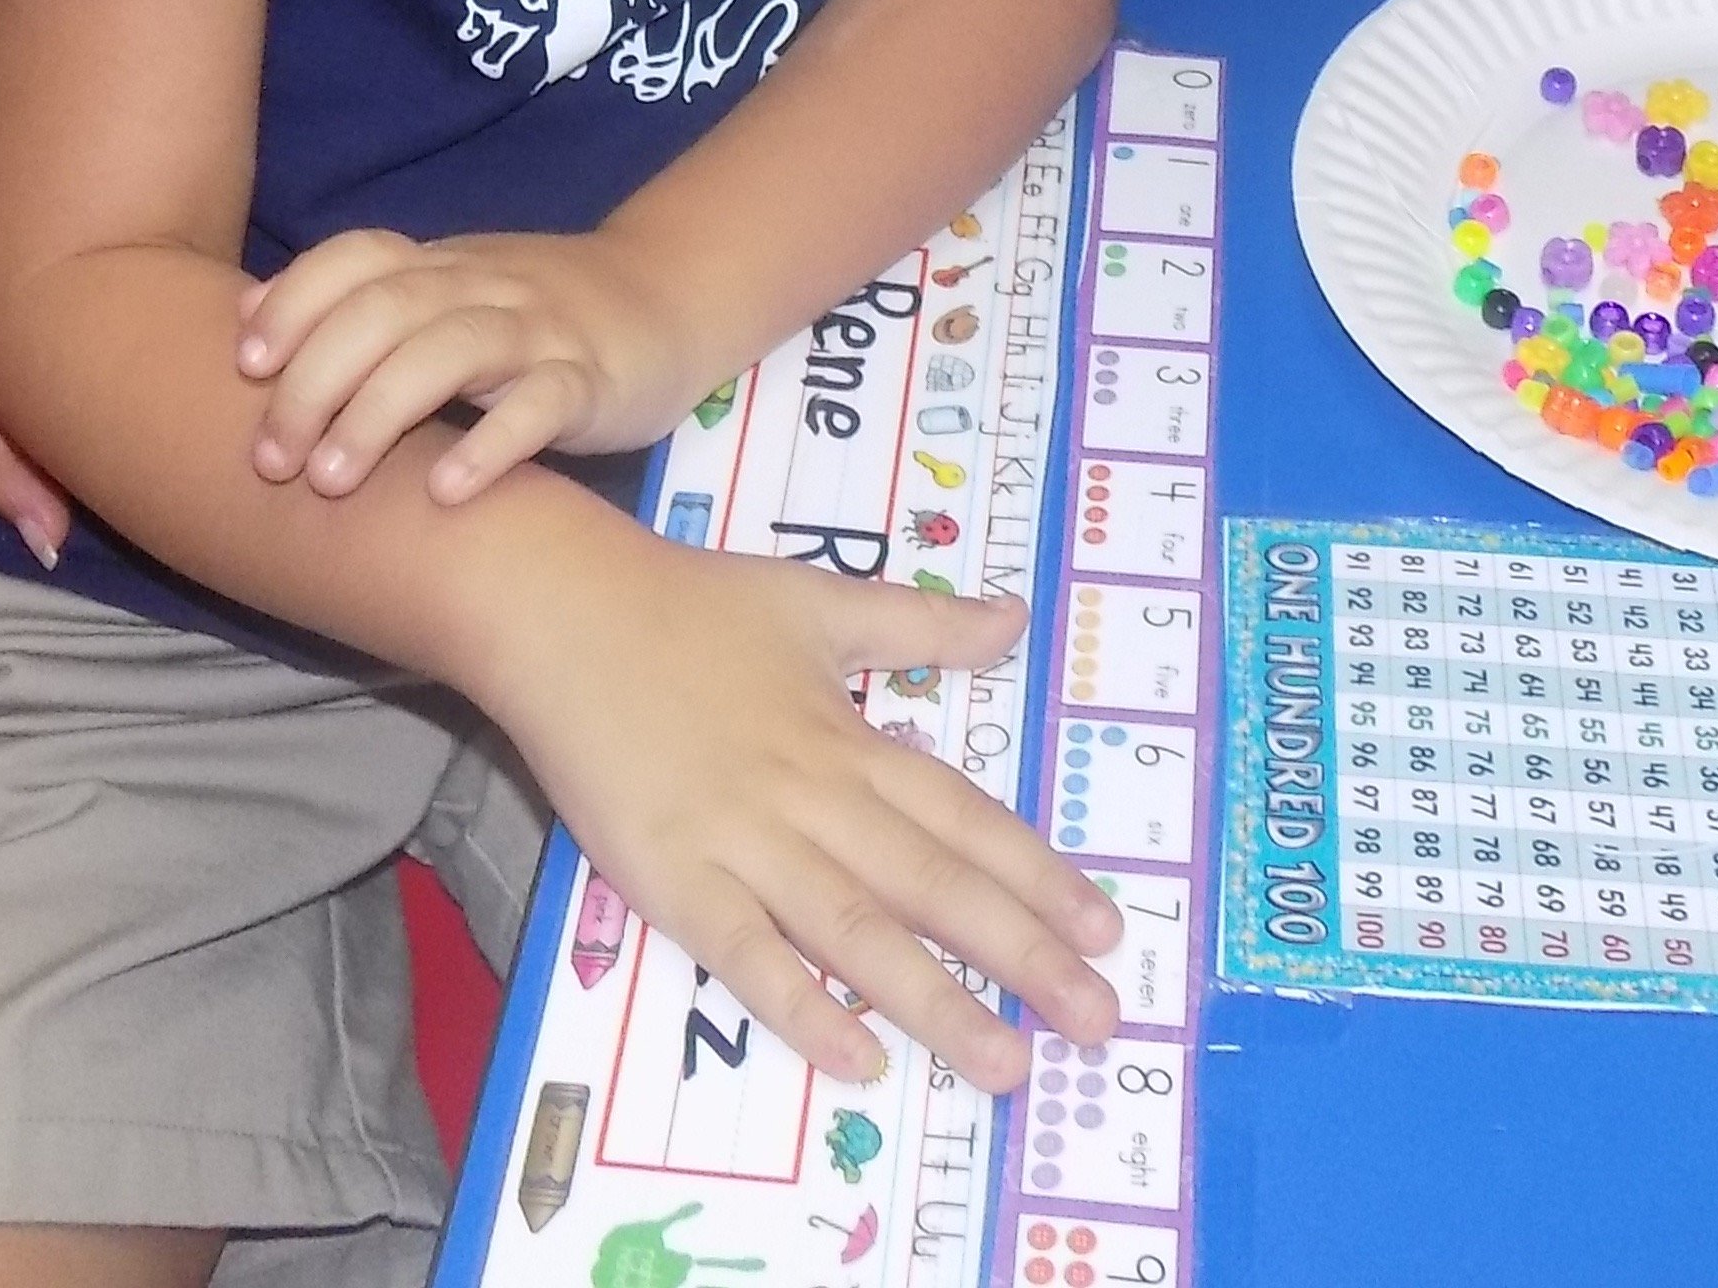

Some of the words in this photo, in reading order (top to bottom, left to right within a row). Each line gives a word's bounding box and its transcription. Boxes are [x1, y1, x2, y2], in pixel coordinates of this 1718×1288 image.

[1173, 69, 1212, 89] 0
[1161, 259, 1205, 276] 2
[805, 280, 924, 440] Rene
[1156, 366, 1201, 385] 3
[1150, 482, 1196, 501] 4
[1347, 553, 1370, 569] 91
[1401, 555, 1424, 573] 81
[1455, 560, 1479, 576] 71
[1509, 562, 1532, 580] 61
[1264, 542, 1321, 623] ONE
[1672, 573, 1698, 591] 31
[1348, 588, 1372, 609] 92
[1403, 591, 1427, 613] 82
[1459, 595, 1482, 616] 72
[1512, 598, 1537, 620] 62
[1143, 606, 1192, 629] 5
[1678, 609, 1704, 632] 32
[1349, 625, 1373, 646] 93
[1404, 628, 1429, 649] 83
[1461, 632, 1485, 653] 73
[1516, 635, 1541, 657] 63
[1684, 648, 1710, 670] 33
[1350, 663, 1374, 685] 94
[1406, 666, 1431, 688] 84
[1463, 670, 1488, 693] 74
[1519, 674, 1545, 697] 64
[1689, 686, 1715, 709] 34
[1351, 702, 1376, 726] 95
[1408, 706, 1433, 730] 85
[1466, 710, 1490, 734] 75
[1522, 714, 1548, 738] 65
[1263, 633, 1325, 850] HUNDRED
[1135, 743, 1185, 766] 6
[1352, 743, 1377, 767] 96
[1410, 747, 1436, 771] 86
[1468, 752, 1494, 775] 76
[1526, 755, 1552, 779] 66
[1354, 785, 1379, 811] 97
[1412, 789, 1437, 815] 87
[1471, 794, 1496, 819] 77
[1530, 797, 1556, 823] 67
[1355, 828, 1380, 853] 98
[1414, 832, 1440, 857] 88
[1474, 837, 1500, 862] 78
[1533, 840, 1560, 866] 68
[1356, 872, 1382, 898] 99
[1416, 876, 1443, 903] 89
[1477, 882, 1504, 907] 79
[1126, 899, 1180, 922] 7
[1263, 860, 1329, 945] 100
[1537, 885, 1565, 912] 69
[1357, 913, 1383, 948] 100
[1418, 922, 1445, 948] 90
[1480, 926, 1506, 953] 80
[1542, 931, 1568, 958] 70
[1138, 948, 1158, 1009] seven
[1117, 1064, 1173, 1096] 8
[1119, 1131, 1157, 1188] eight
[1106, 1254, 1166, 1286] 9
